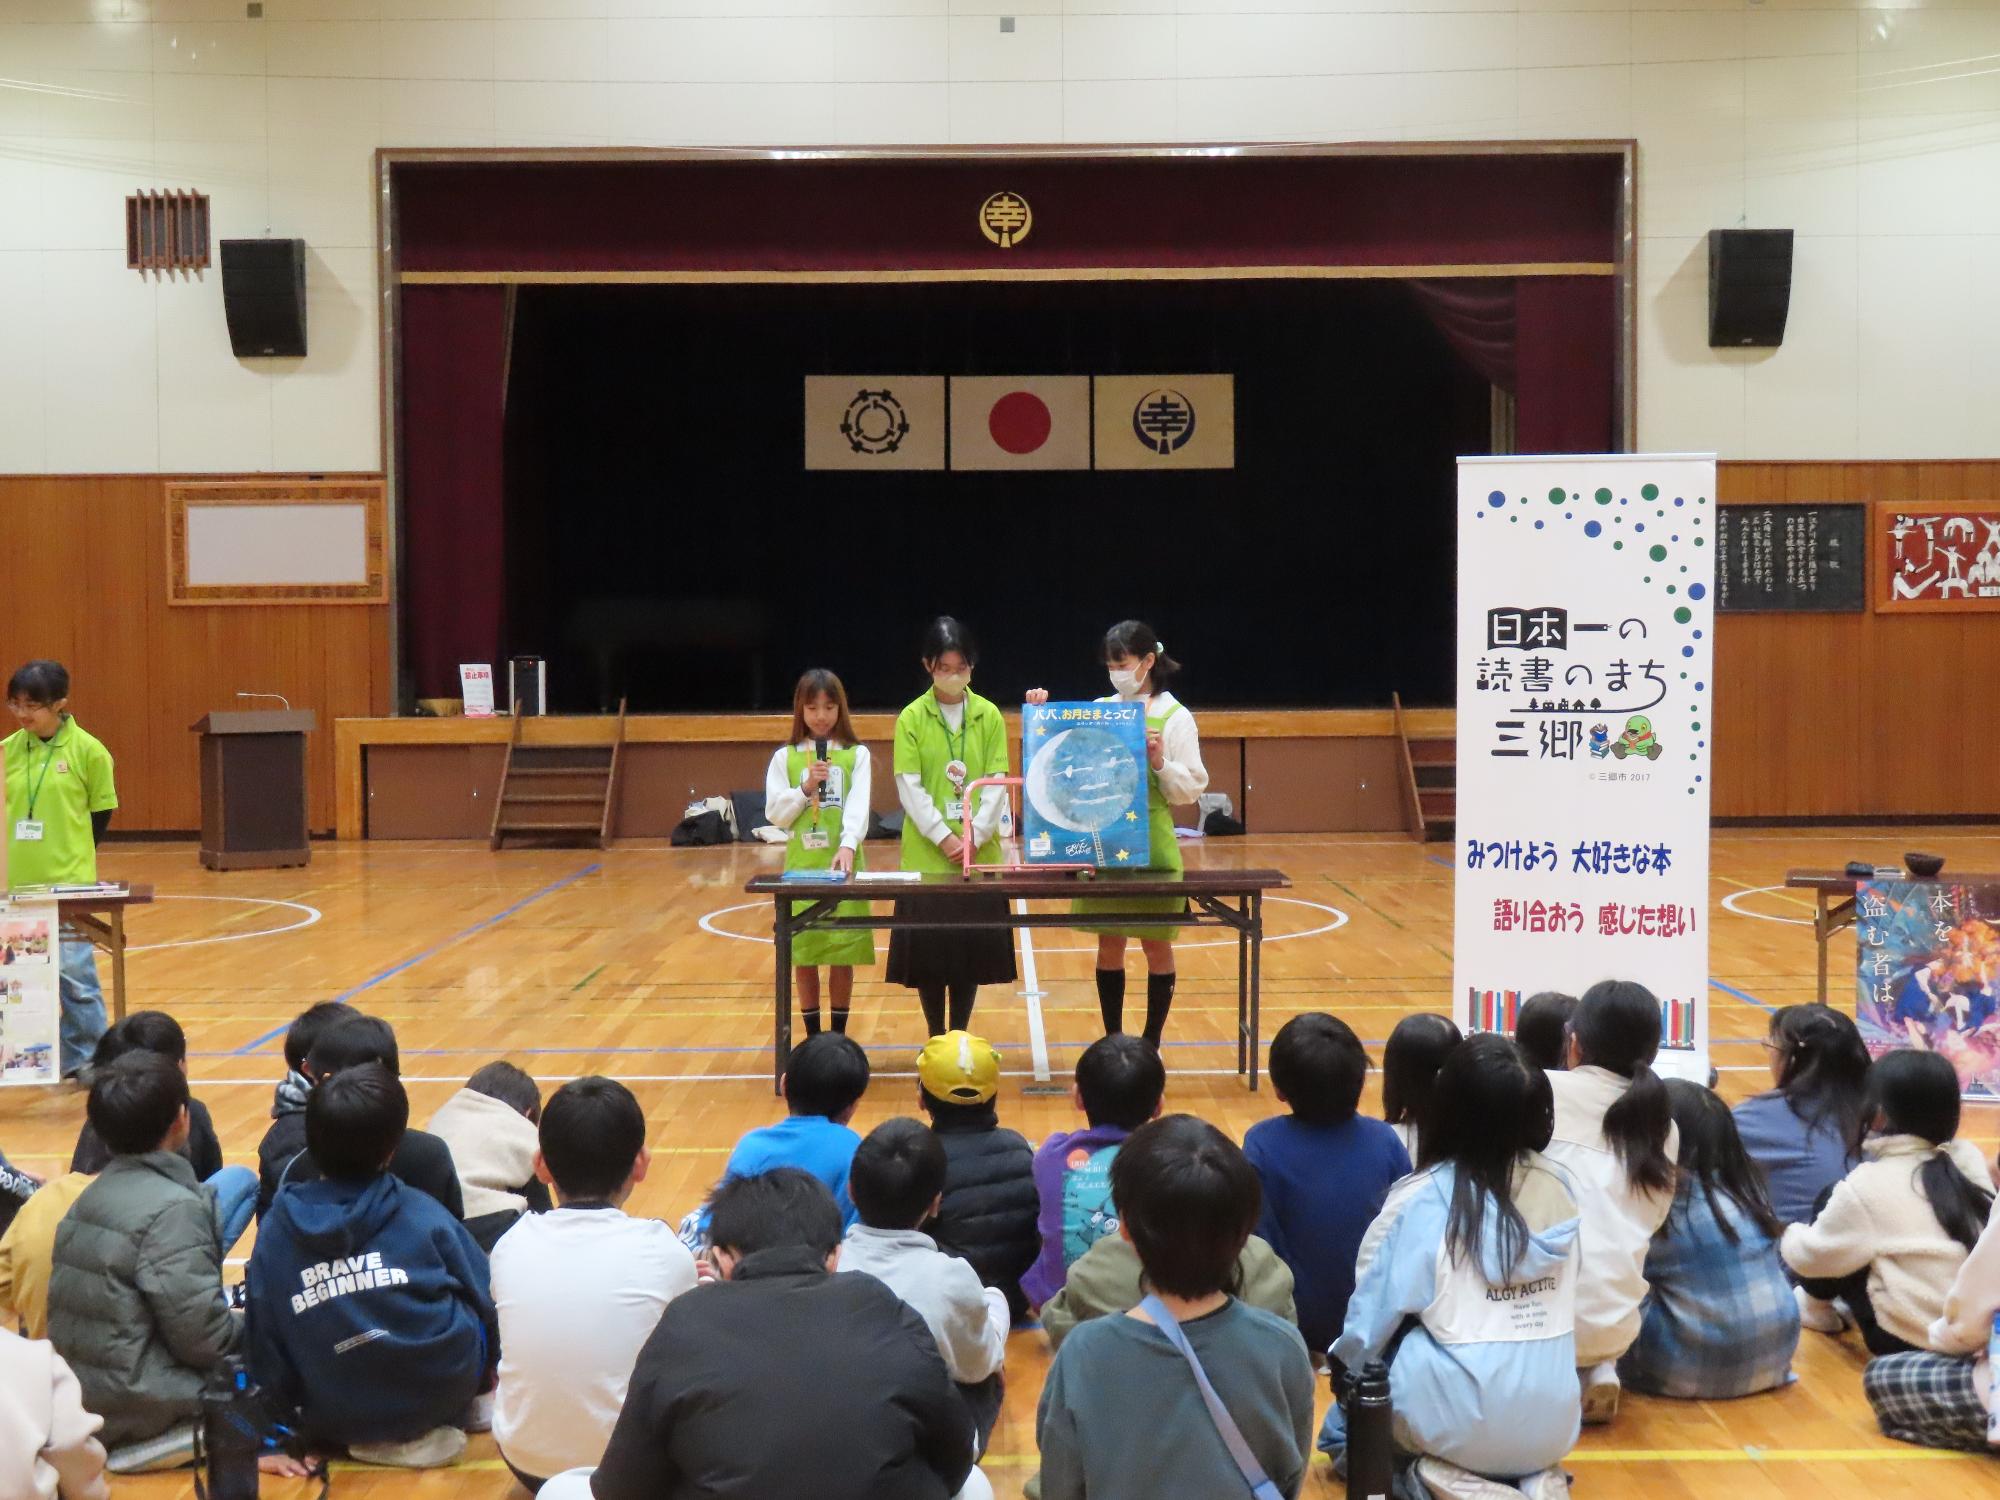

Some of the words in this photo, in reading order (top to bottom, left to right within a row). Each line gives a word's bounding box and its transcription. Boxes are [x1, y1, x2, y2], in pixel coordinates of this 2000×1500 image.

[1489, 608, 1647, 649] 日本一の
[1476, 656, 1667, 713] 読書のまち
[1491, 720, 1584, 760] 三郷
[1630, 773, 1651, 781] 2017
[1467, 839, 1558, 872] みつけよう
[1571, 841, 1672, 876] 大好きな本
[1493, 898, 1584, 934] 語り合おう
[1598, 902, 1696, 938] 感じた想い
[1928, 889, 1955, 942] 本を
[1862, 894, 1895, 1003] 盗む者は
[301, 1251, 383, 1288] BRAVE
[291, 1268, 409, 1315] BEGINNER
